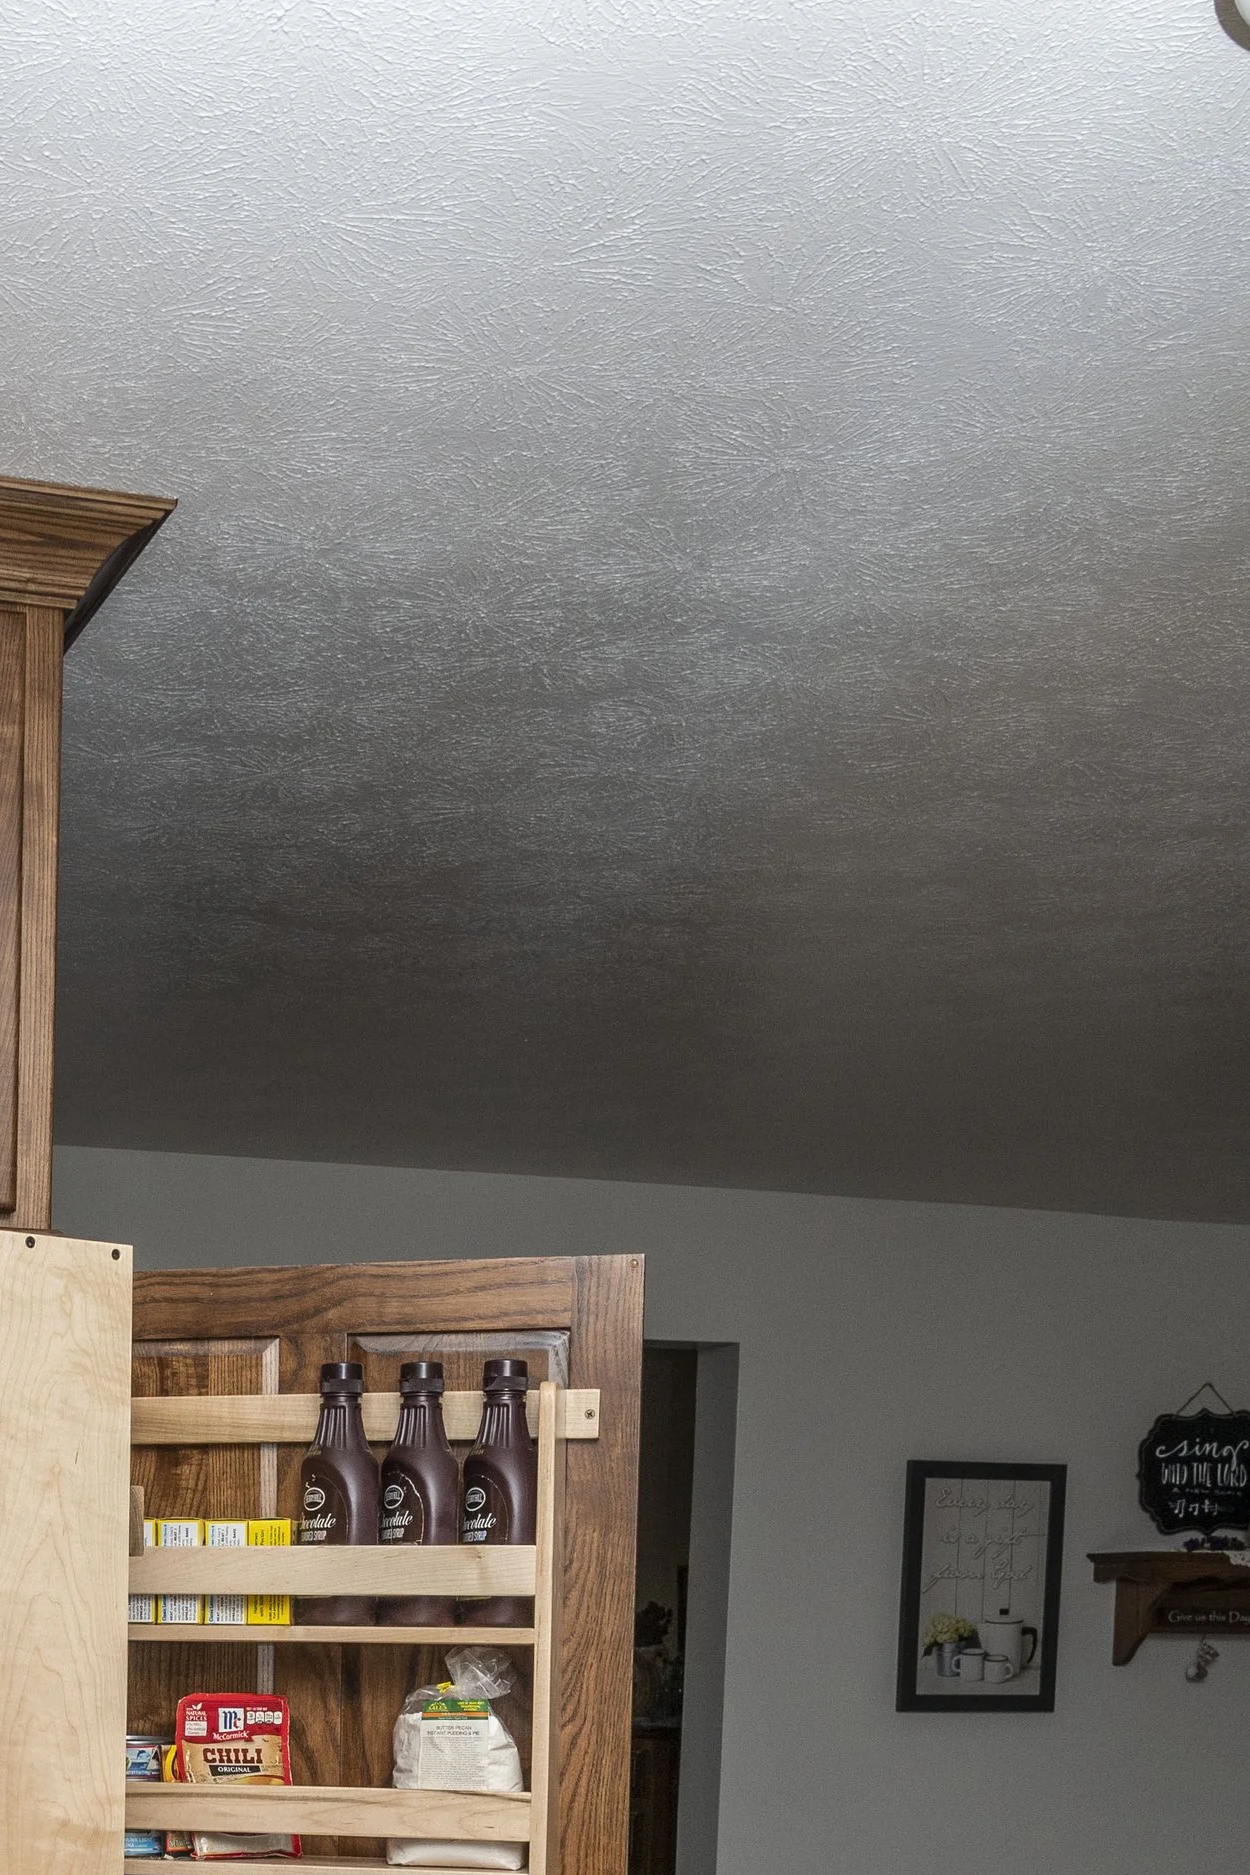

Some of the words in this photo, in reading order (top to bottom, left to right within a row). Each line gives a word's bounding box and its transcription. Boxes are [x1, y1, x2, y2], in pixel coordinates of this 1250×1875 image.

[1156, 1438, 1249, 1471] sing
[1192, 1462, 1212, 1487] THE
[1218, 1464, 1247, 1487] LORD
[1168, 1610, 1192, 1622] Give
[212, 1731, 249, 1741] McCormick
[202, 1748, 263, 1764] CHILI
